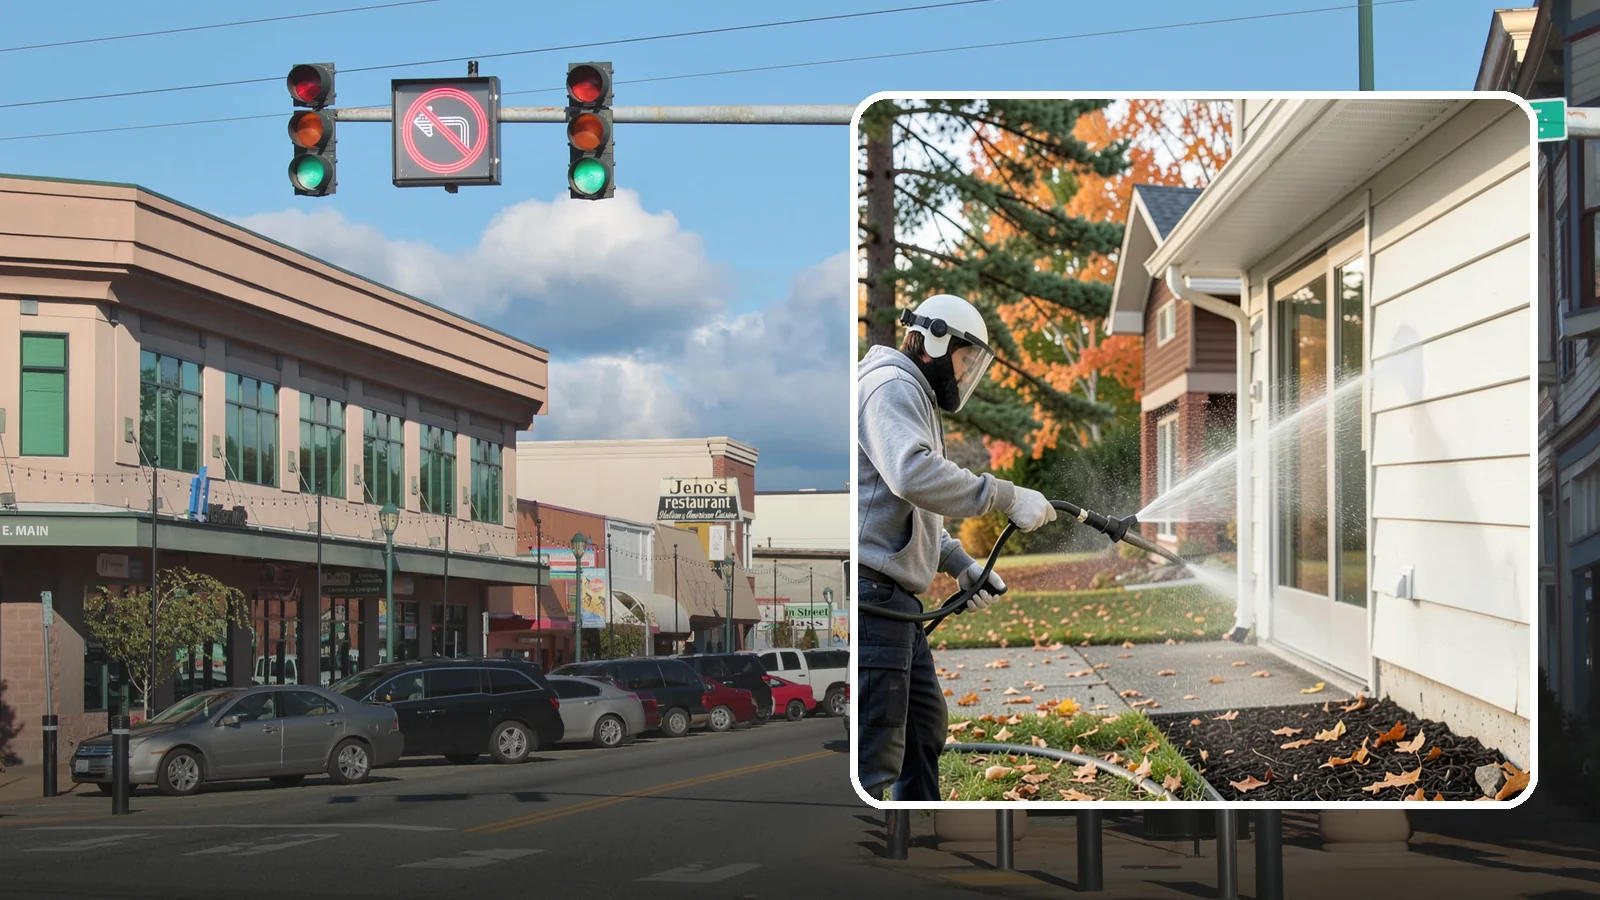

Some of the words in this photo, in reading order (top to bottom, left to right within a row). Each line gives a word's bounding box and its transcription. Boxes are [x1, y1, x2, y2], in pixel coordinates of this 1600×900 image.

[670, 480, 727, 494] Jeno's
[665, 496, 731, 509] restaurant
[659, 510, 682, 520] Italian
[686, 510, 714, 520] American
[715, 509, 737, 519] Cuisine
[2, 525, 13, 536] E.
[15, 525, 49, 536] MAIN
[797, 607, 828, 616] Street
